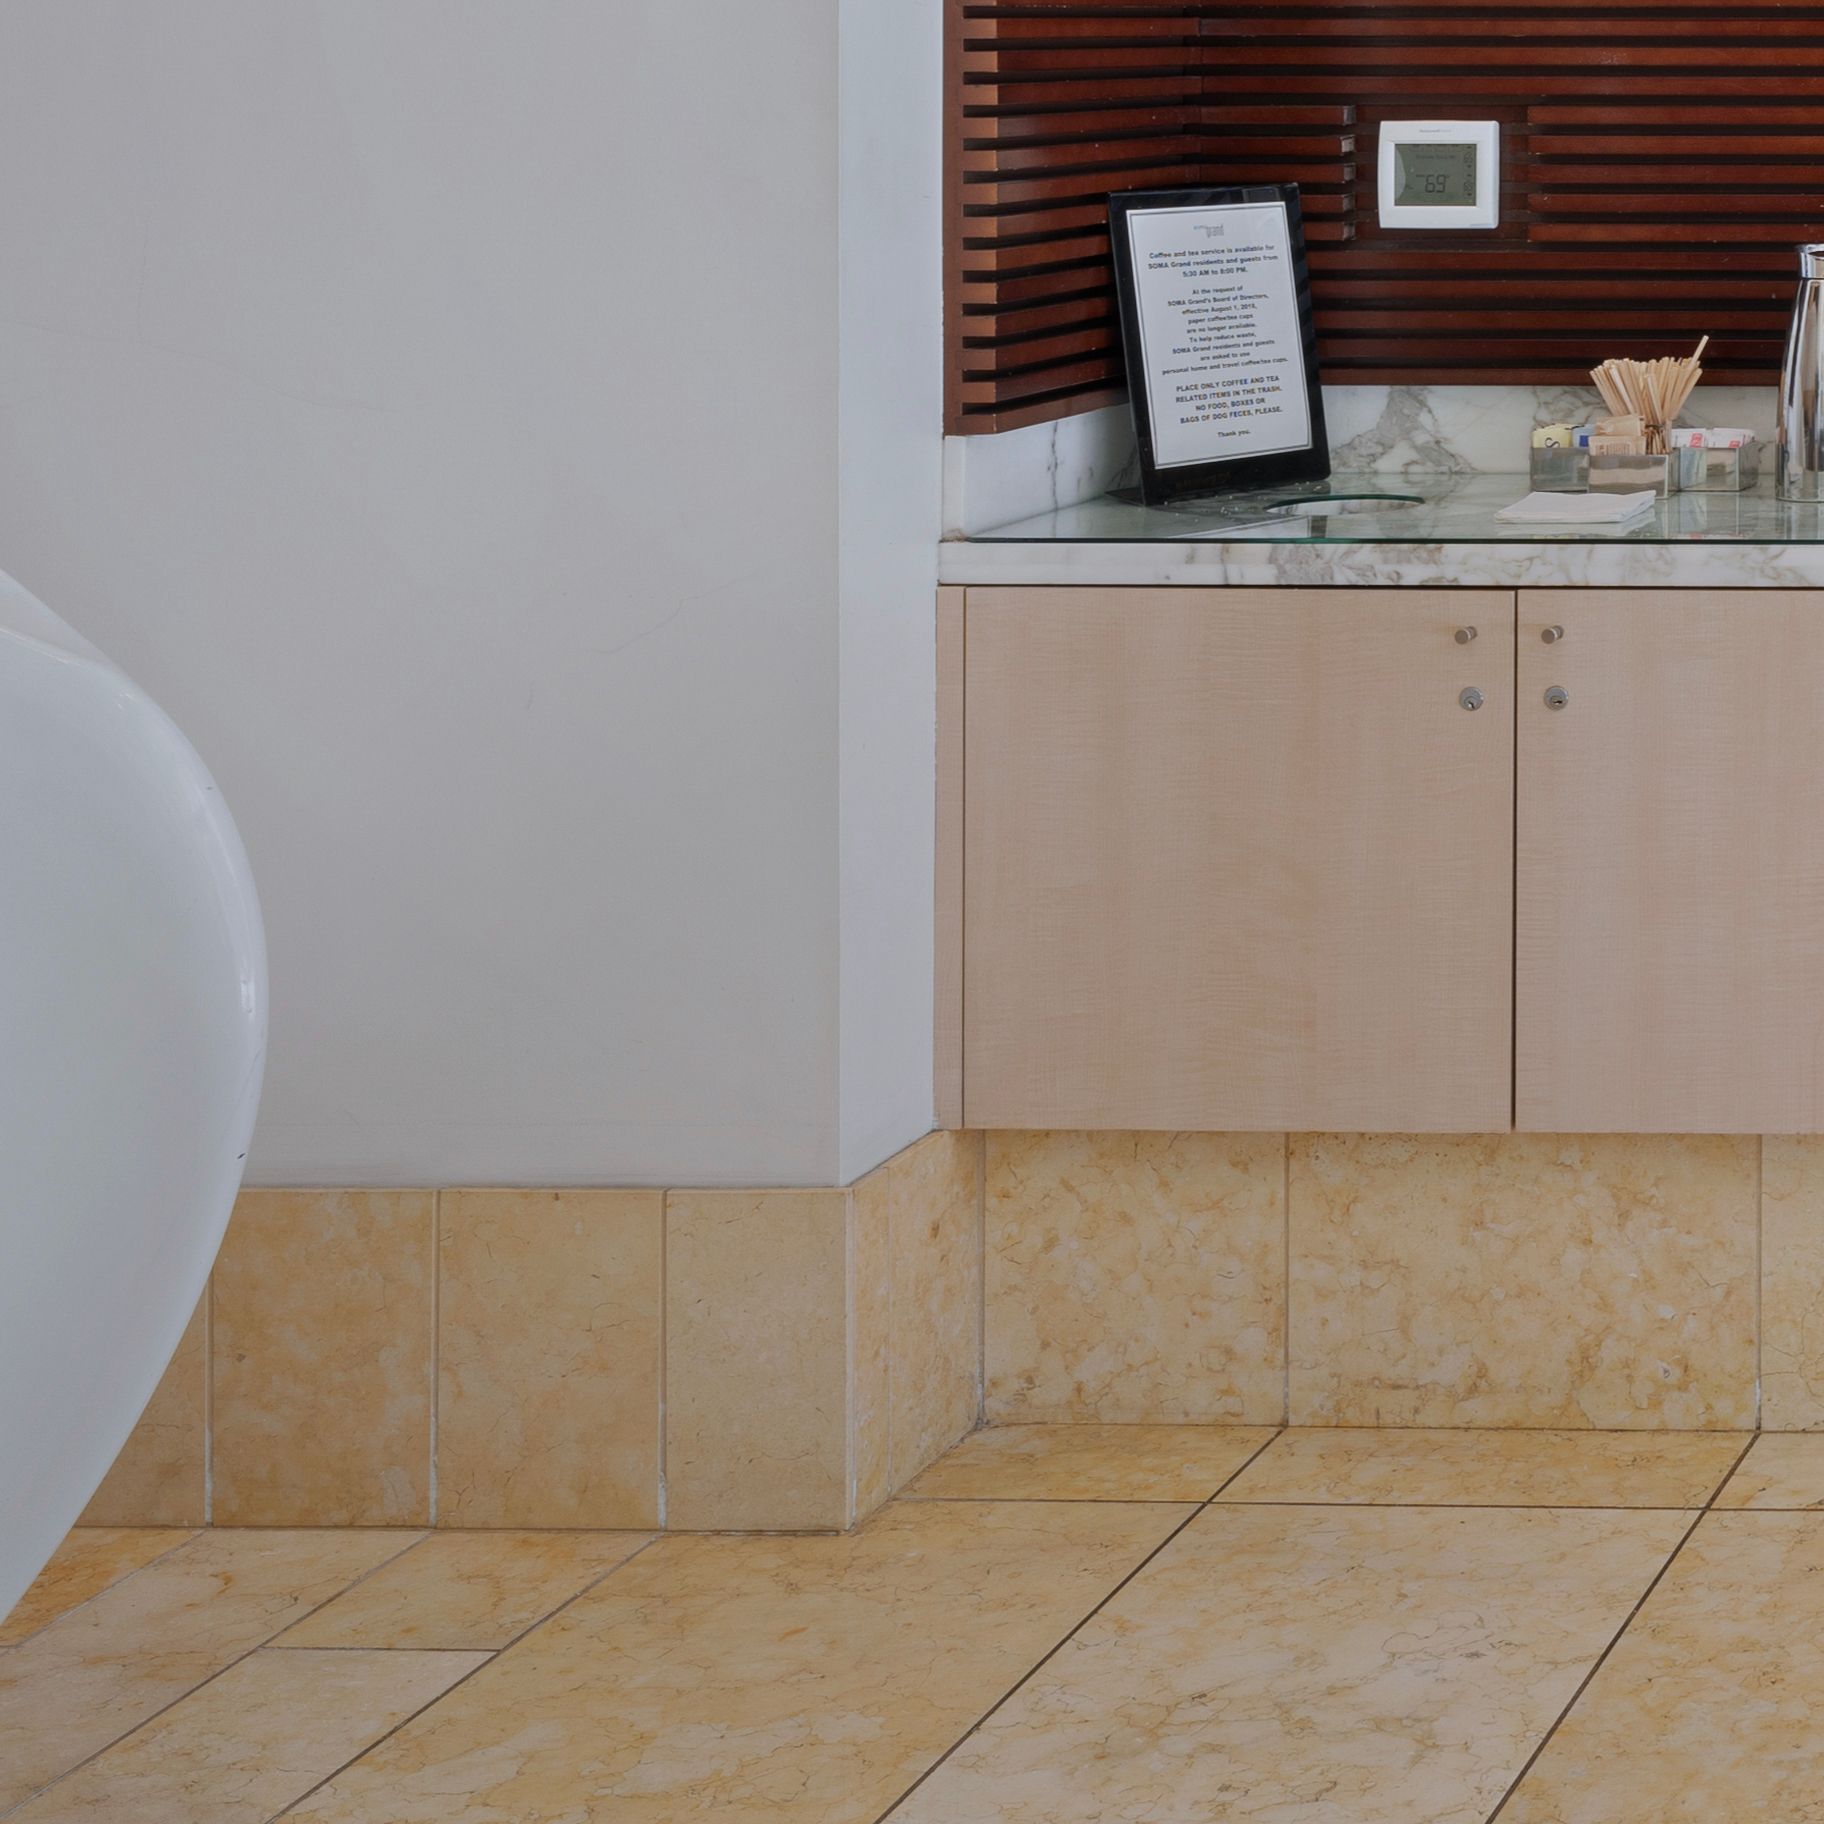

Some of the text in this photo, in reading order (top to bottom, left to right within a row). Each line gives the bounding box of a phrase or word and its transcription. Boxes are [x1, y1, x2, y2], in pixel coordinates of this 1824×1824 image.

[1240, 256, 1261, 264] guests
[1182, 307, 1209, 315] effective
[1211, 305, 1232, 313] August
[1255, 339, 1275, 347] guests
[1162, 366, 1189, 375] personal
[1177, 384, 1198, 392] PLACE
[1222, 379, 1248, 388] COFFEE
[1176, 395, 1207, 403] RELATED
[1210, 391, 1231, 399] ITEMS
[1208, 402, 1229, 410] FOOD,
[1231, 399, 1253, 408] BOXES
[1181, 416, 1199, 424] BAGS
[1213, 412, 1227, 420] DOG
[1229, 410, 1253, 418] FECES,
[1255, 406, 1282, 415] PLEASE.
